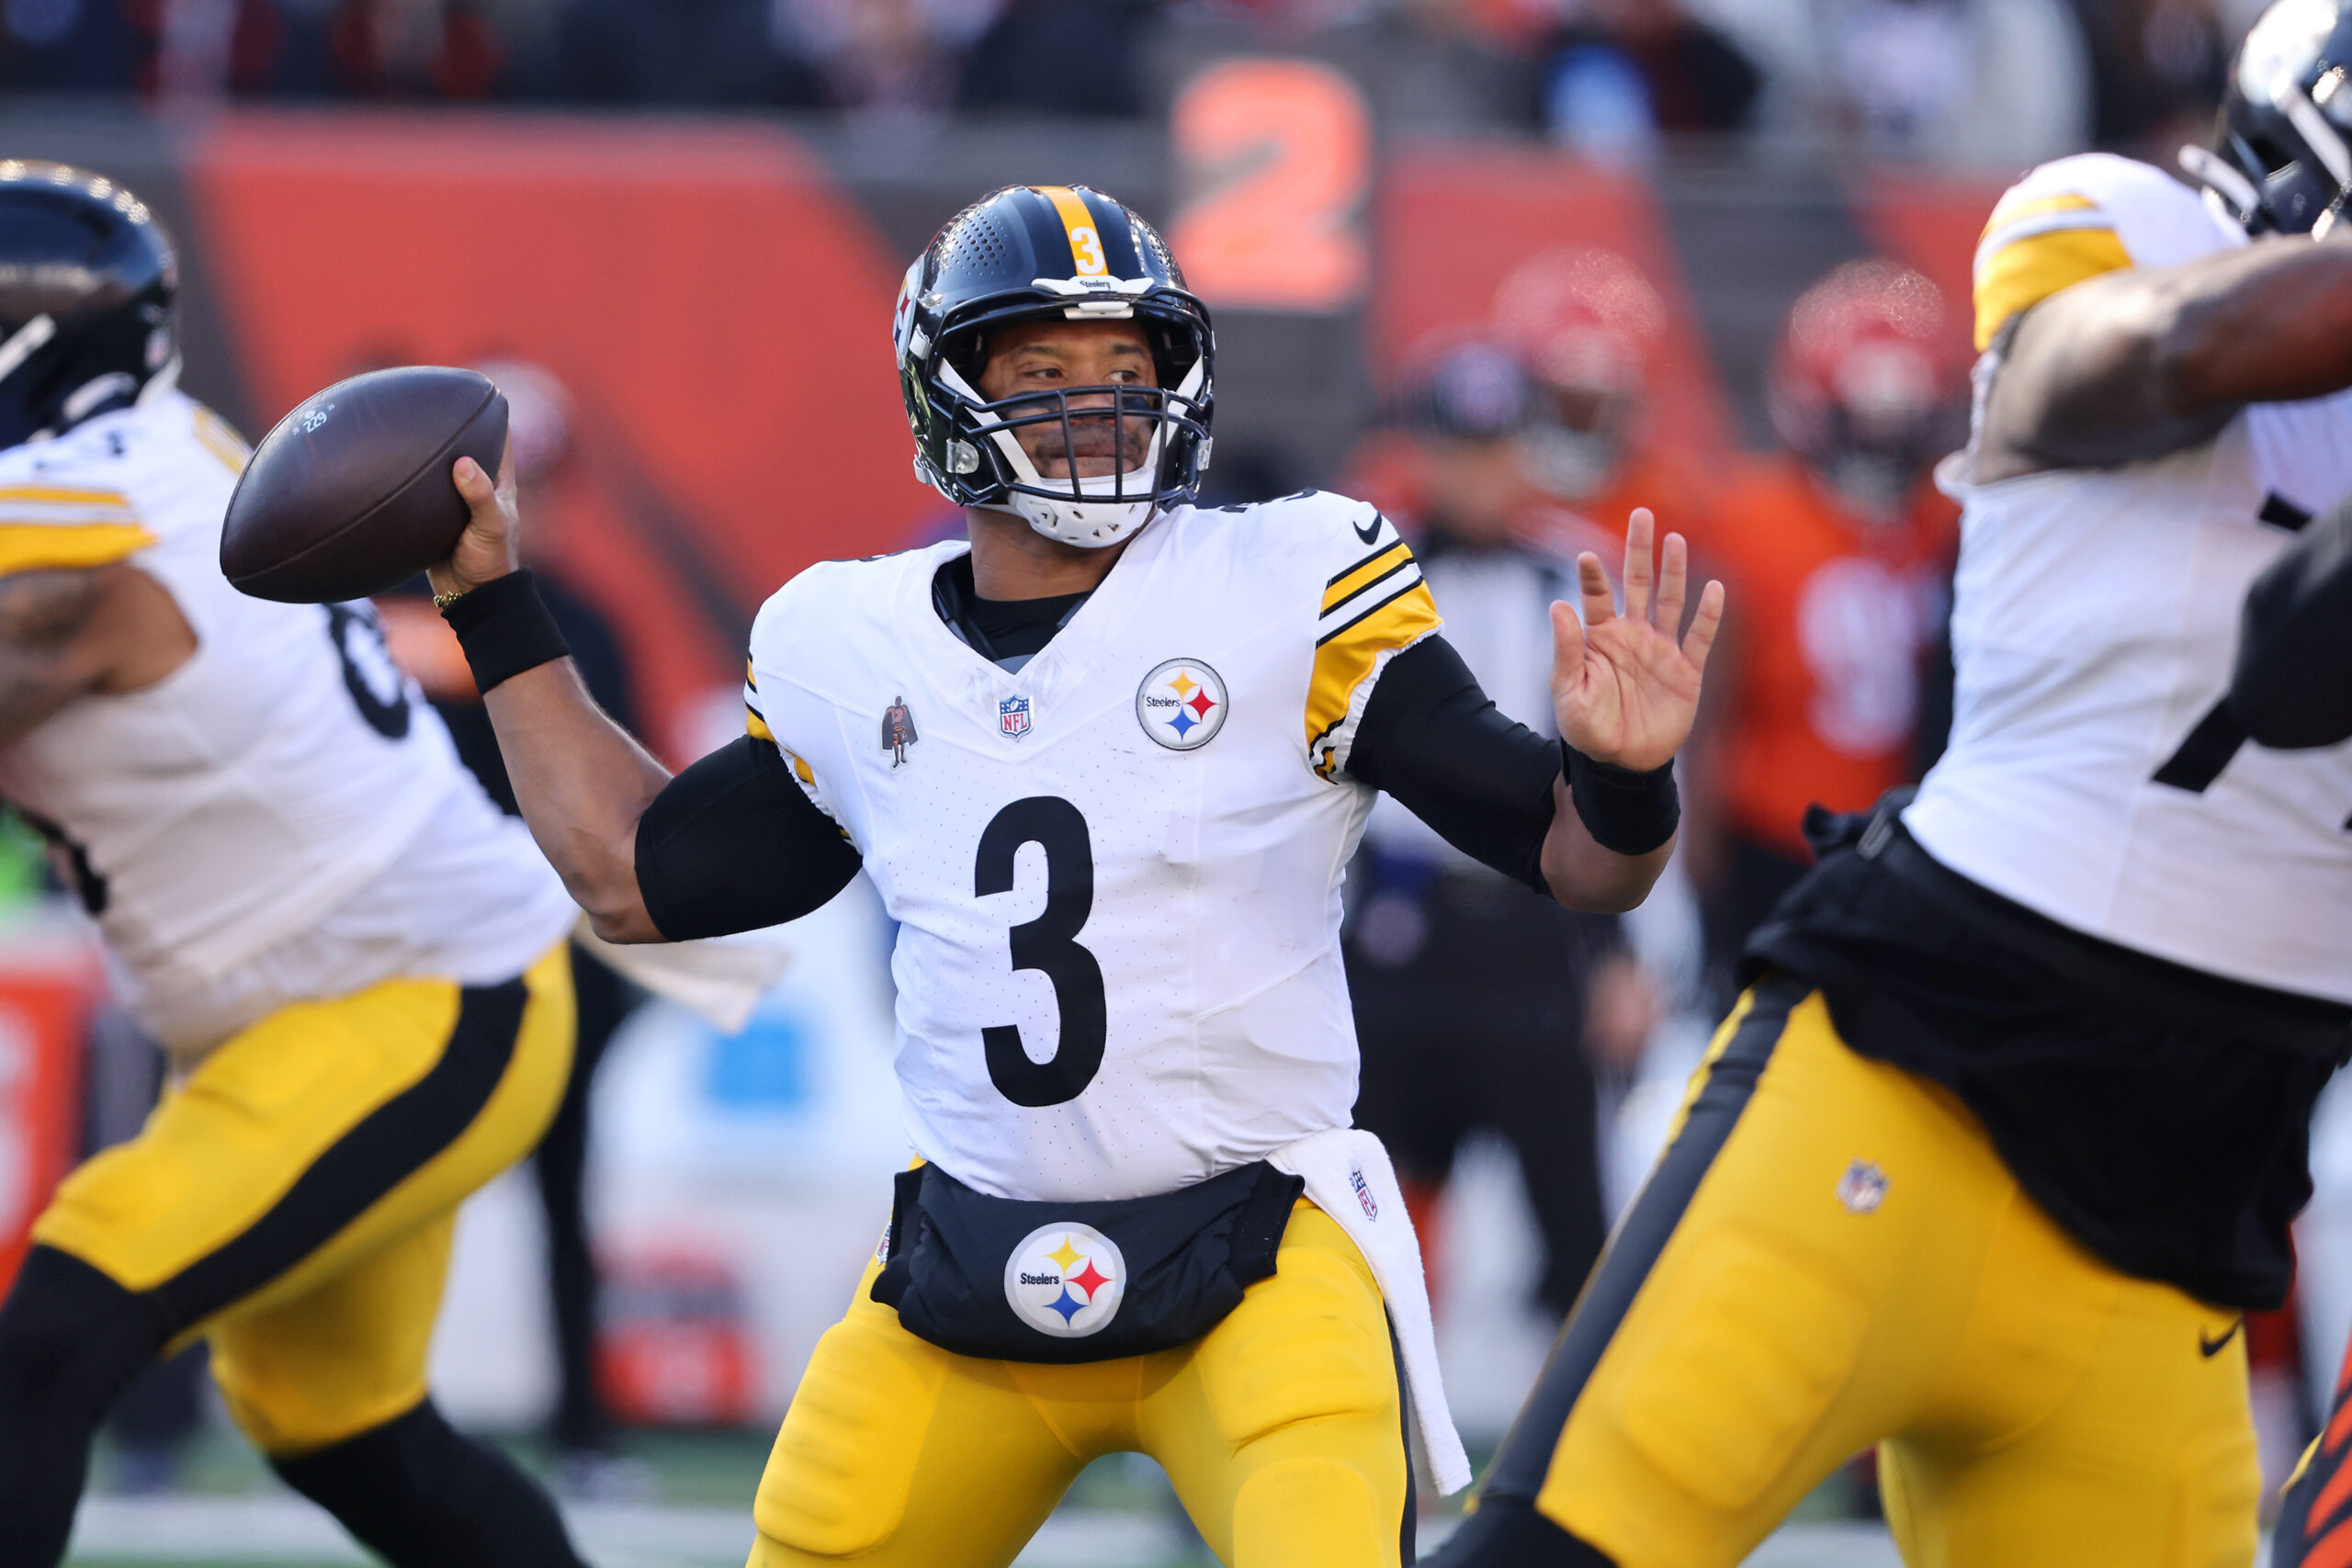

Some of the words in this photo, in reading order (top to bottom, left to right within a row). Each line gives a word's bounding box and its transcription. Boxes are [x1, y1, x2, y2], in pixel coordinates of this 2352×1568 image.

[1170, 59, 1372, 308] 2
[1070, 226, 1105, 275] 3
[1080, 279, 1111, 291] Steelers
[302, 411, 328, 434] 229
[1146, 696, 1181, 707] Steelers
[1002, 713, 1028, 733] NFL
[974, 795, 1108, 1108] 3
[1020, 1272, 1060, 1285] Steelers
